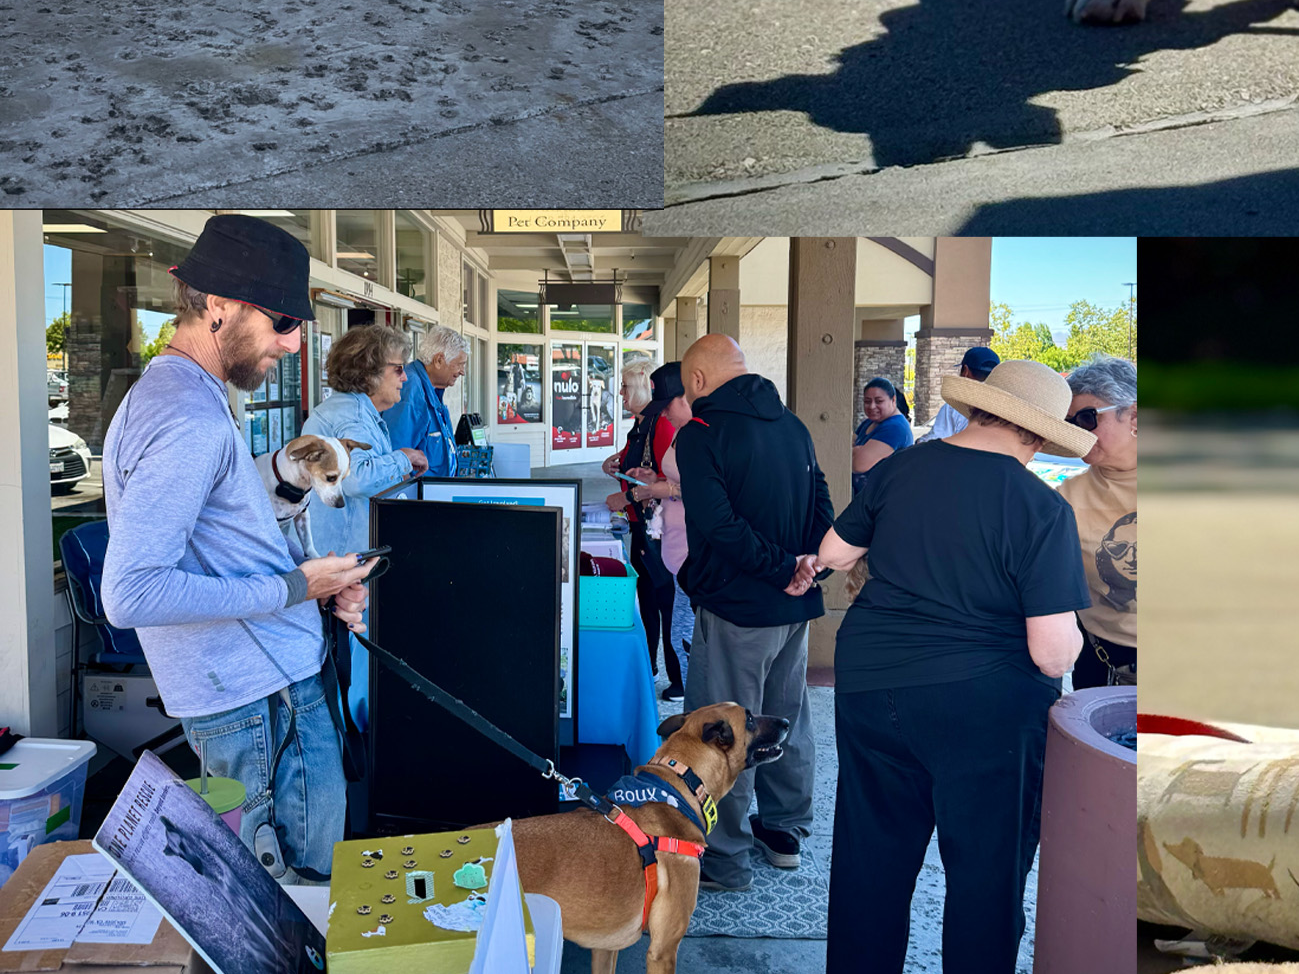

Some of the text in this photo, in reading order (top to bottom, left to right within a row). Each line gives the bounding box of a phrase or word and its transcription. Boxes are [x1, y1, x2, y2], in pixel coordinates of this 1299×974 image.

[508, 216, 607, 230] Pet Company
[553, 378, 579, 393] nulo
[614, 787, 659, 803] ROUX
[108, 780, 156, 859] ONE PLANET RESCUE
